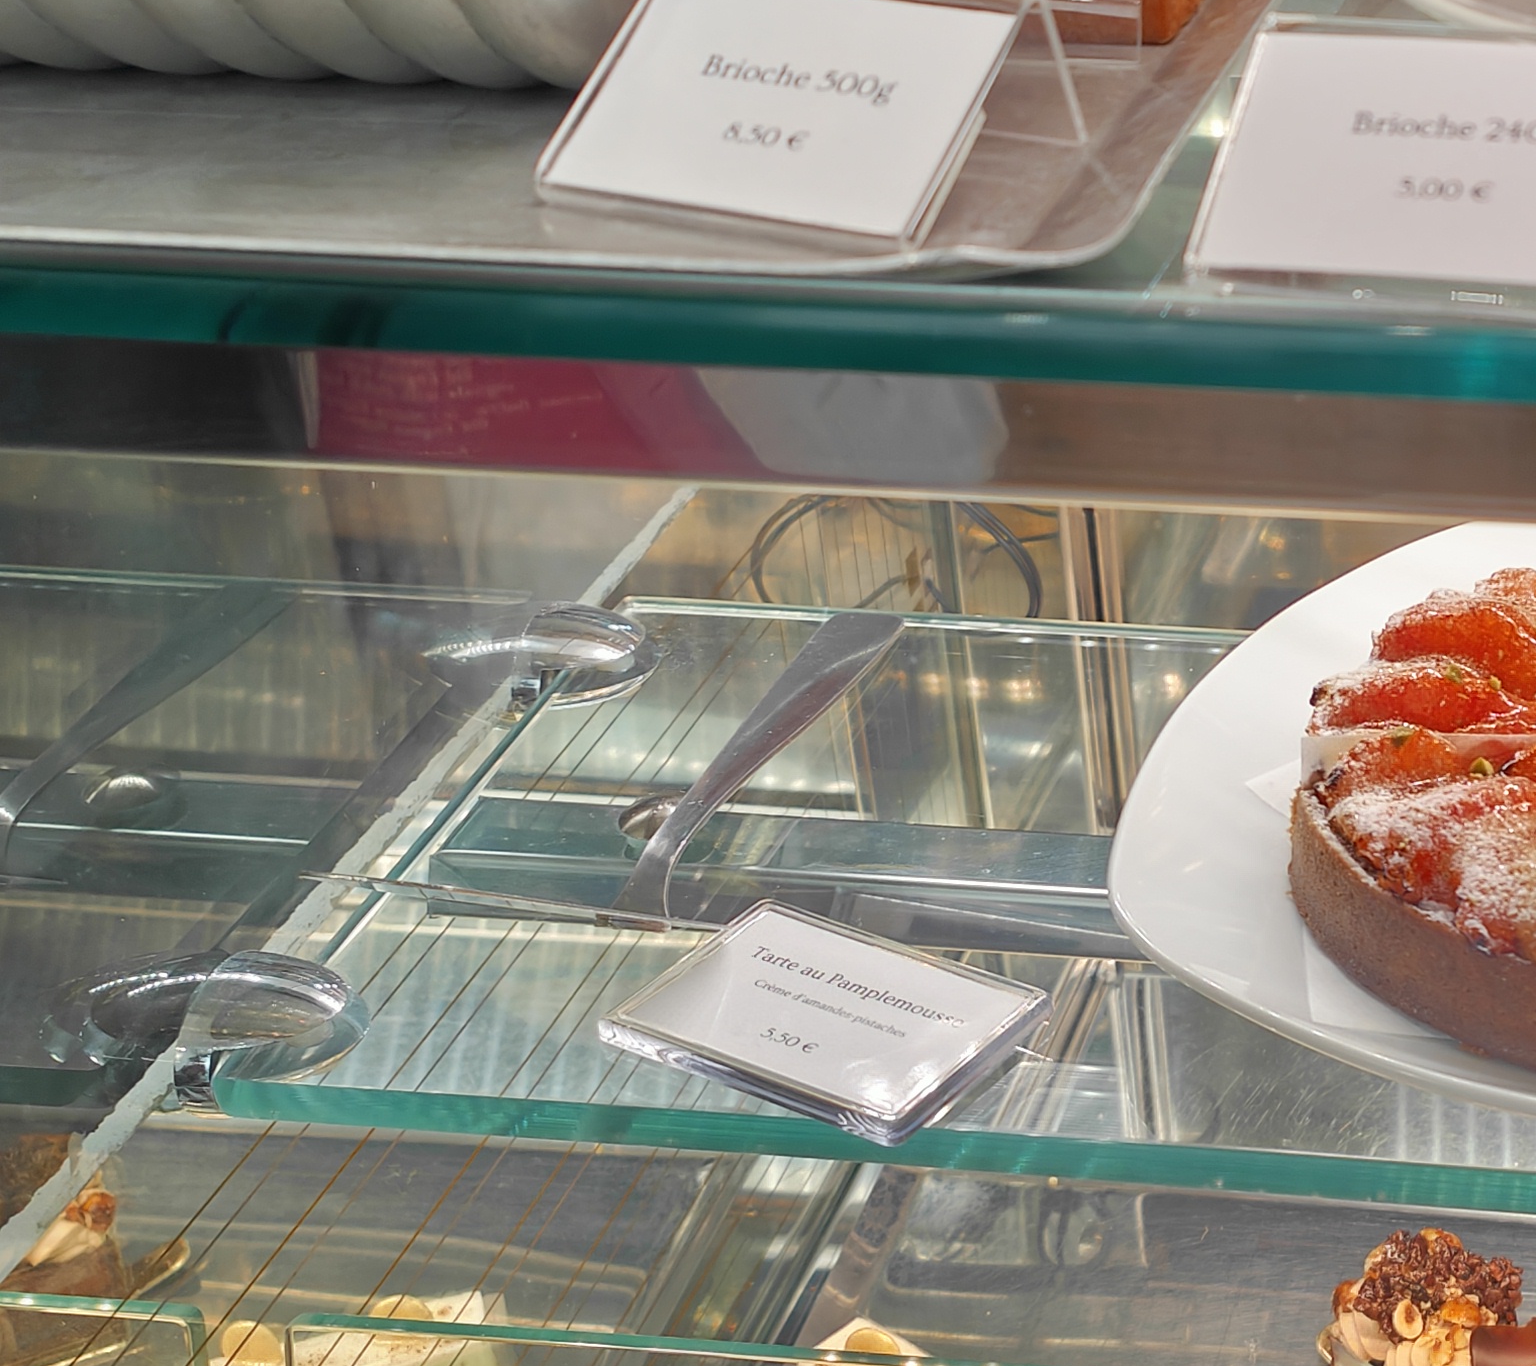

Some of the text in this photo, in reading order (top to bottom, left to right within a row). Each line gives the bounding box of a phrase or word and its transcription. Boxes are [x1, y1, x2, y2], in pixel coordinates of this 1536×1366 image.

[701, 53, 898, 107] Brioche 500g
[1352, 110, 1477, 141] Brioche
[787, 130, 810, 151] €
[1470, 180, 1497, 203] €
[751, 945, 966, 1029] Tarte au Pamplemousse
[754, 979, 791, 1000] Crème
[760, 1026, 819, 1055] 5,50 €
